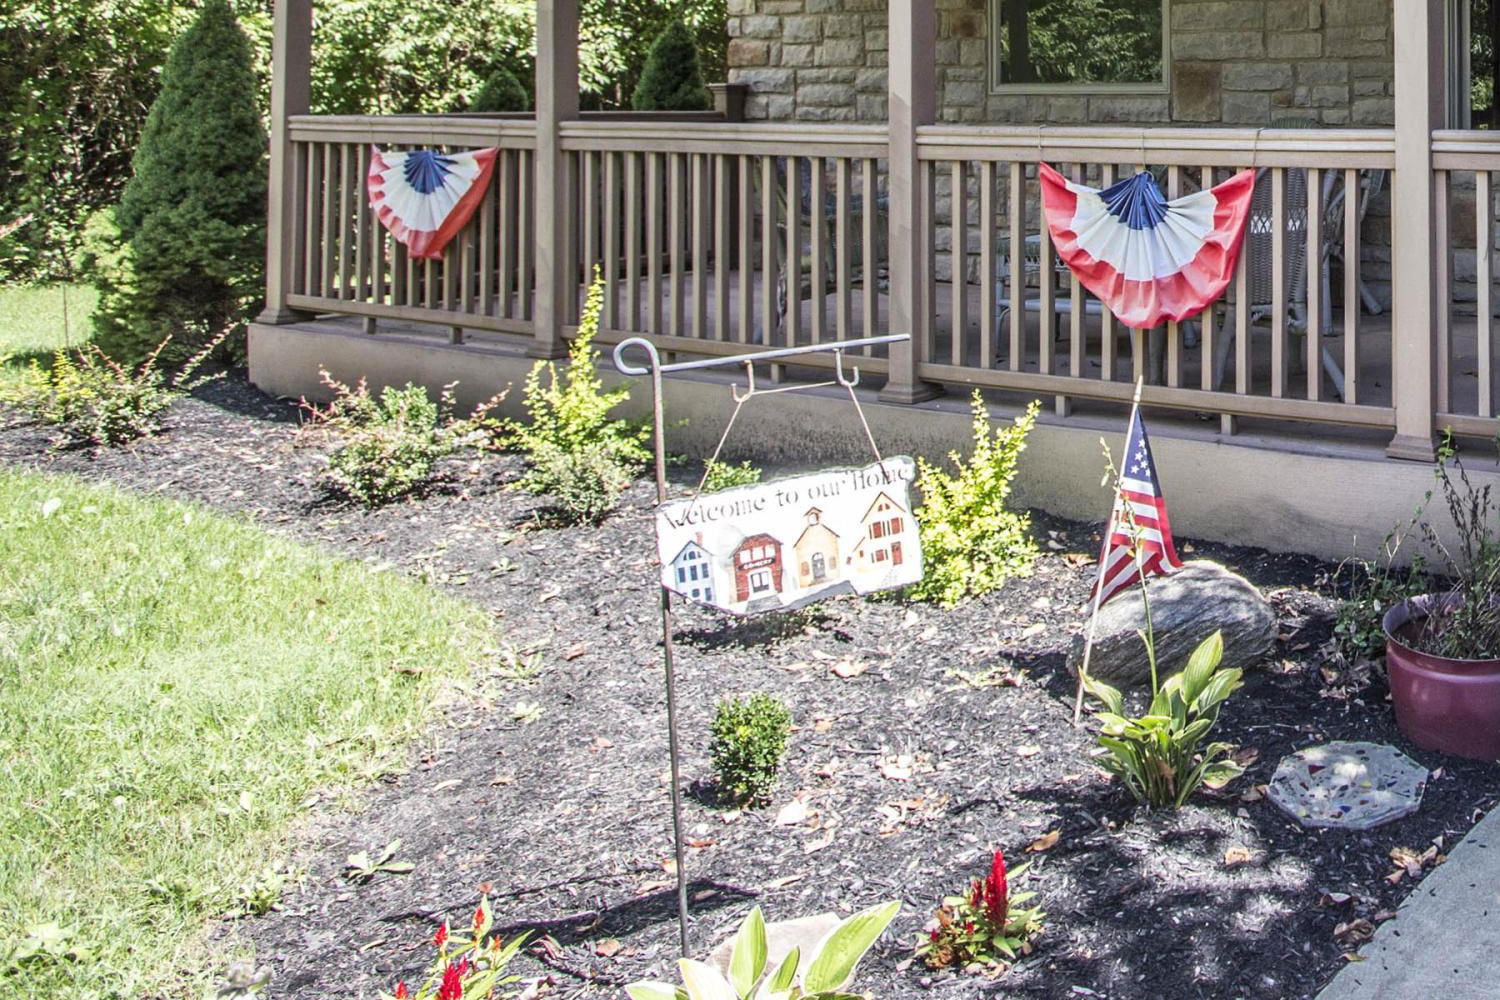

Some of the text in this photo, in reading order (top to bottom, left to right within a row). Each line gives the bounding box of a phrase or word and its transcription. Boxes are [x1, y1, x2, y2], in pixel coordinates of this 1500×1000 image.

[663, 466, 909, 529] Welcome to our Home
